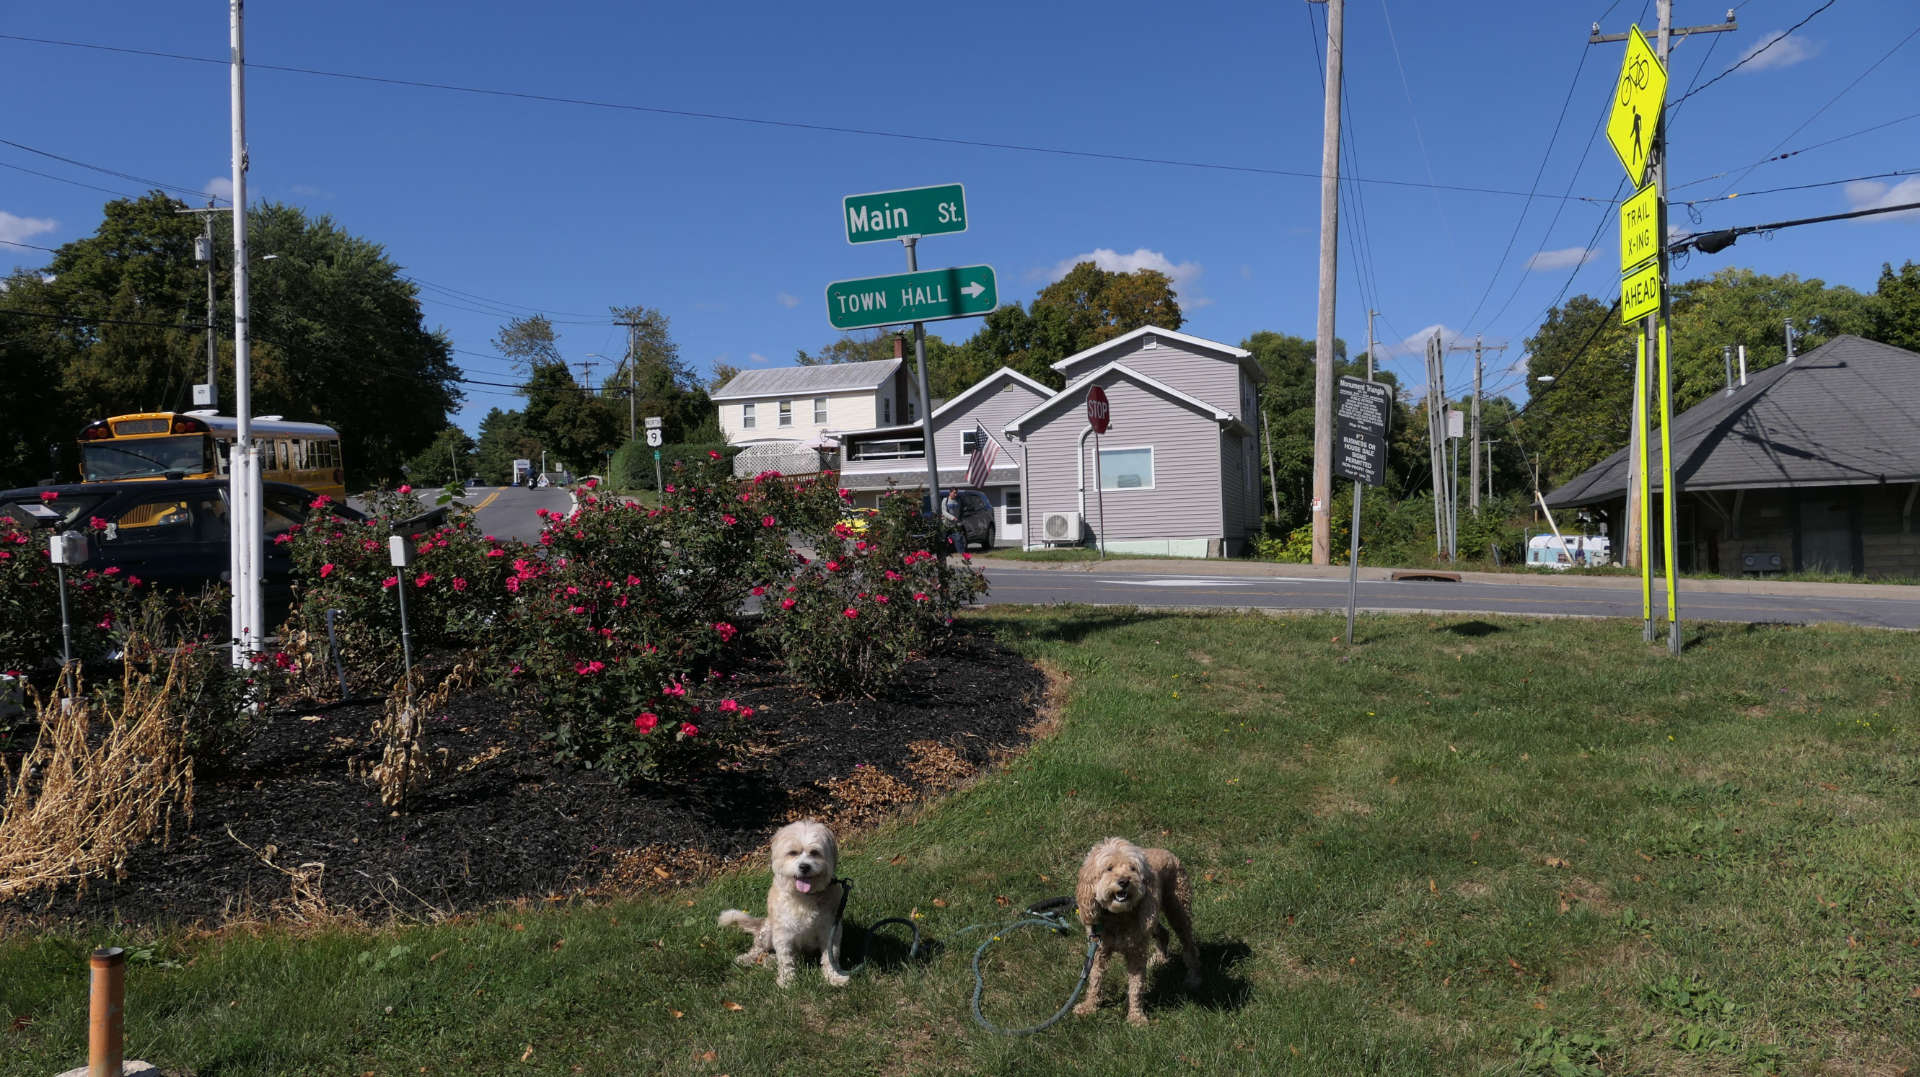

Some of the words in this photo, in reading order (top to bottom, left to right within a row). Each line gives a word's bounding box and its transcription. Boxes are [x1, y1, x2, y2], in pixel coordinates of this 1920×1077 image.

[849, 202, 909, 233] Main
[938, 201, 962, 224] St.
[1627, 201, 1650, 229] TRAIL
[1628, 229, 1650, 256] X-ING
[837, 291, 887, 314] TOWN
[901, 284, 949, 306] HALL
[1624, 276, 1657, 311] AHEAD
[1340, 380, 1365, 391] Monument
[1366, 384, 1384, 396] Triangle
[1088, 399, 1108, 419] STOP
[651, 432, 657, 443] 9
[1344, 436, 1367, 448] BUSINESS
[1368, 443, 1376, 451] OR
[1344, 443, 1361, 453] HOUSE
[1361, 448, 1375, 457] SALE
[1345, 456, 1372, 469] PERMITTED
